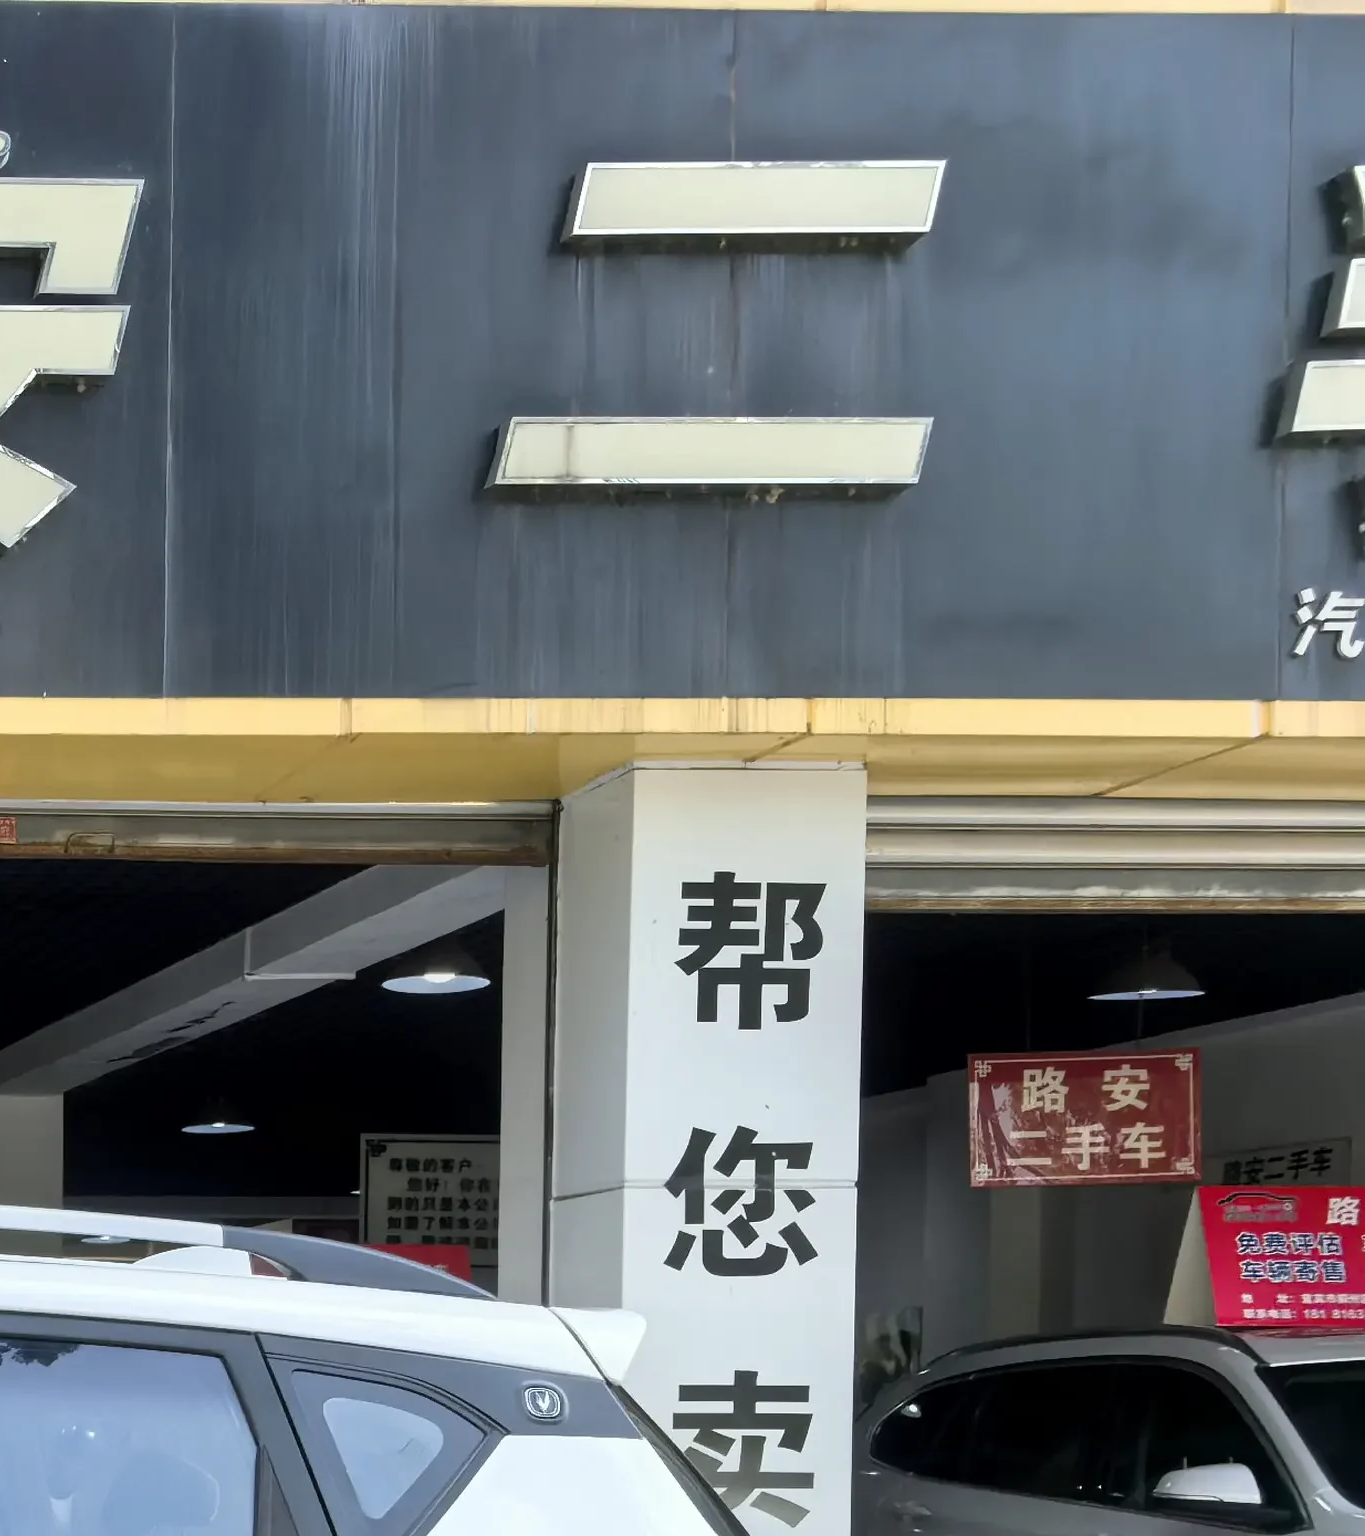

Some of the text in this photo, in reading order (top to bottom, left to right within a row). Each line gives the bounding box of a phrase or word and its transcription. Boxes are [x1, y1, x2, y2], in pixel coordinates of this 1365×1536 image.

[1020, 1064, 1151, 1114] 路安
[1005, 1120, 1167, 1170] 二手车
[664, 871, 824, 1528] 帮您卖
[1324, 1196, 1361, 1226] 路
[1235, 1232, 1342, 1256] 免费评估
[1240, 1259, 1346, 1283] 车辆寄售
